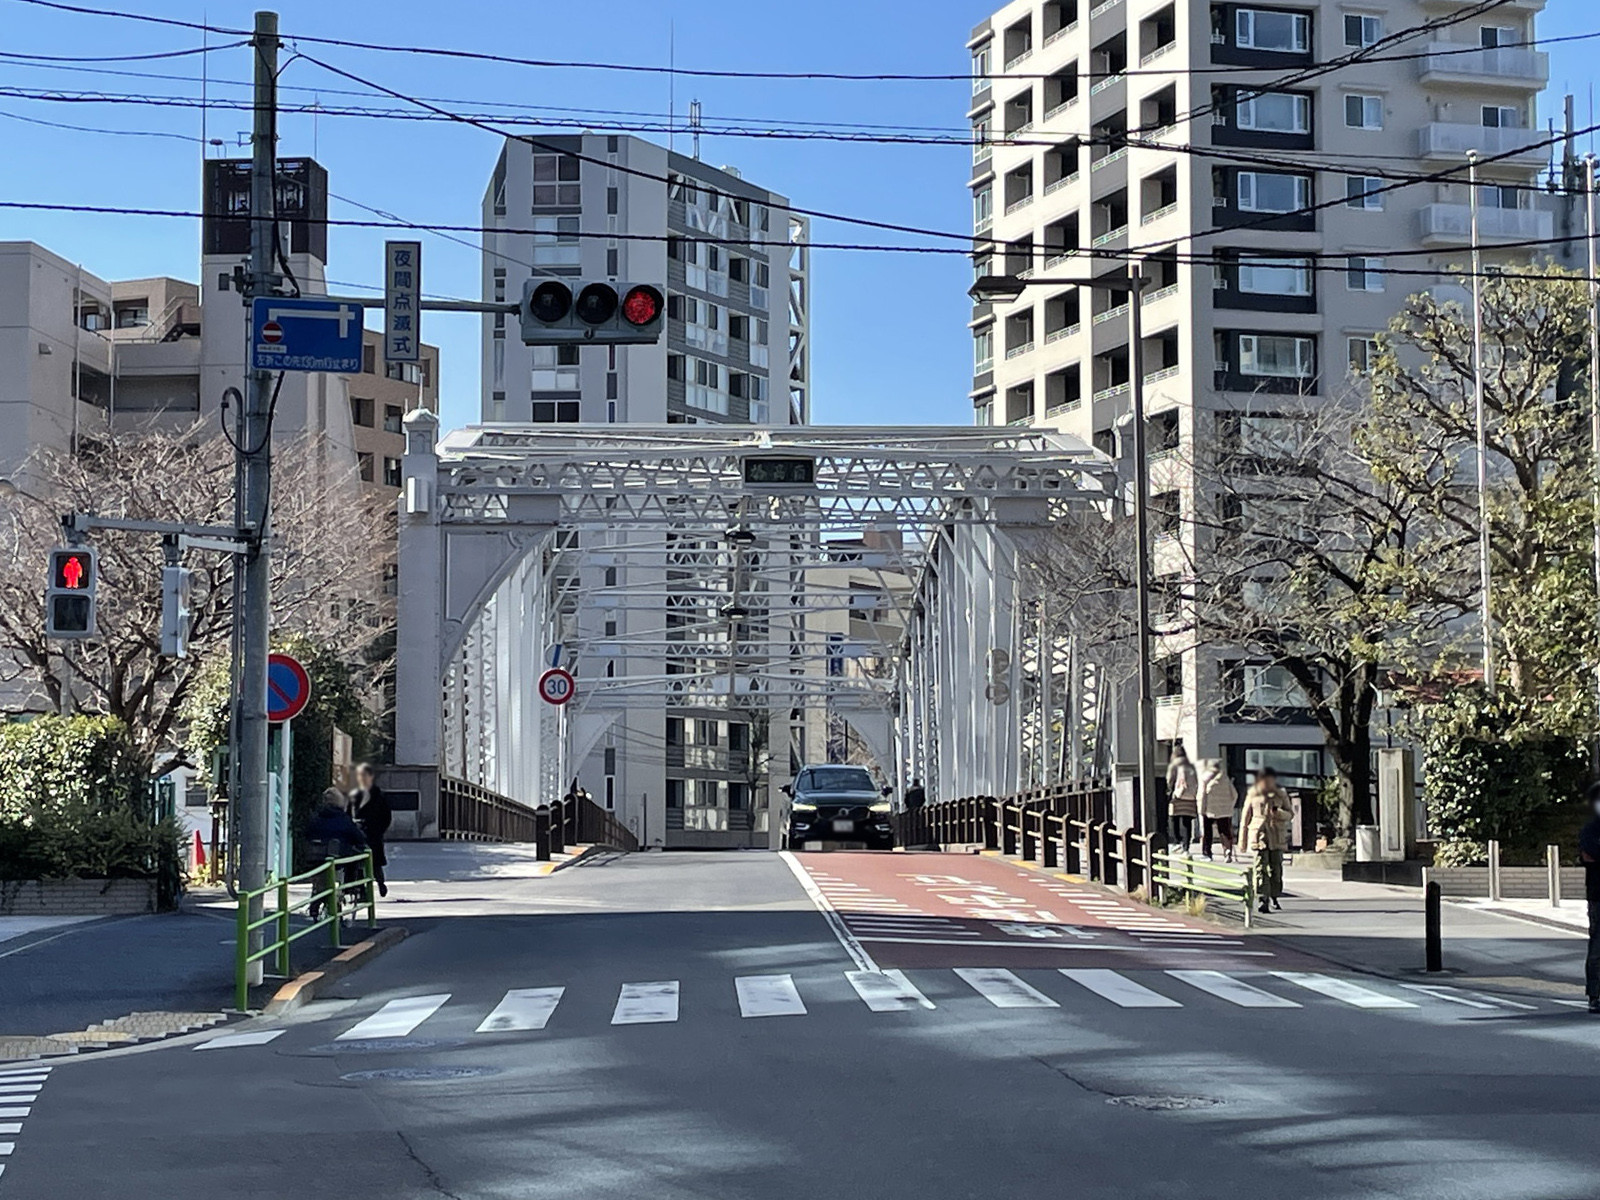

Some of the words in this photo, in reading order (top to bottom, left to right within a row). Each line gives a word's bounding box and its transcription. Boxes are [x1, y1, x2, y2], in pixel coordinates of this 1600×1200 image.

[392, 249, 412, 354] 夜間点滅式
[547, 679, 568, 695] 30
